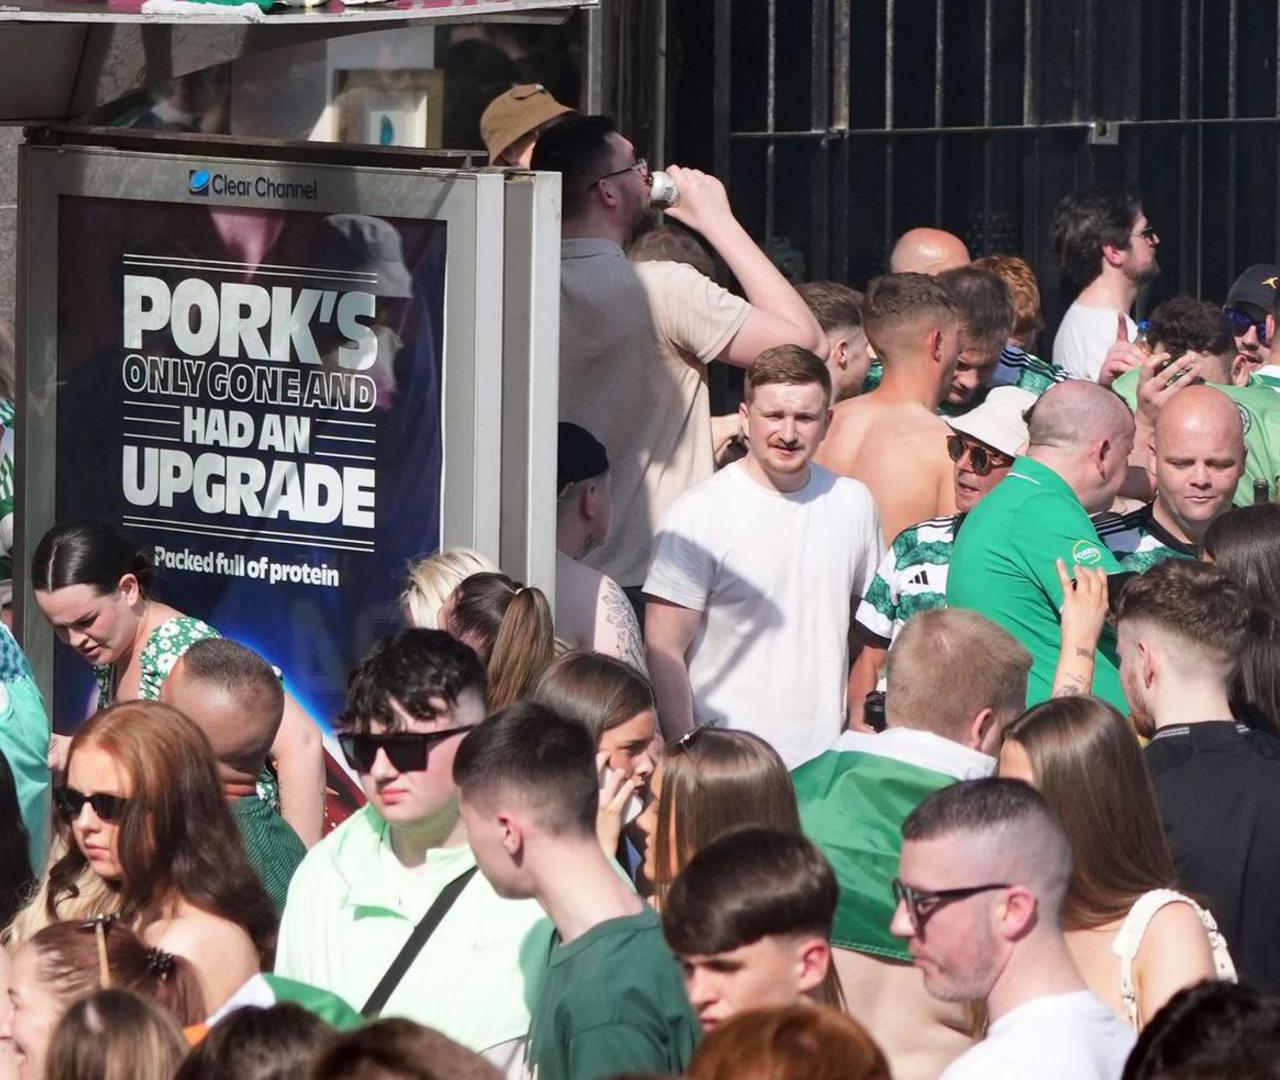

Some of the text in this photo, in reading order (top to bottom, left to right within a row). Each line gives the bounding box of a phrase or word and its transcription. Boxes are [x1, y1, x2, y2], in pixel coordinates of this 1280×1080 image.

[212, 173, 318, 200] Clear Channel
[123, 274, 378, 370] PORK'S
[122, 354, 378, 413] ONLY GONE AND
[183, 406, 311, 454] HAD AN
[122, 444, 376, 529] UPGRADE
[154, 545, 340, 587] Packed full of protein
